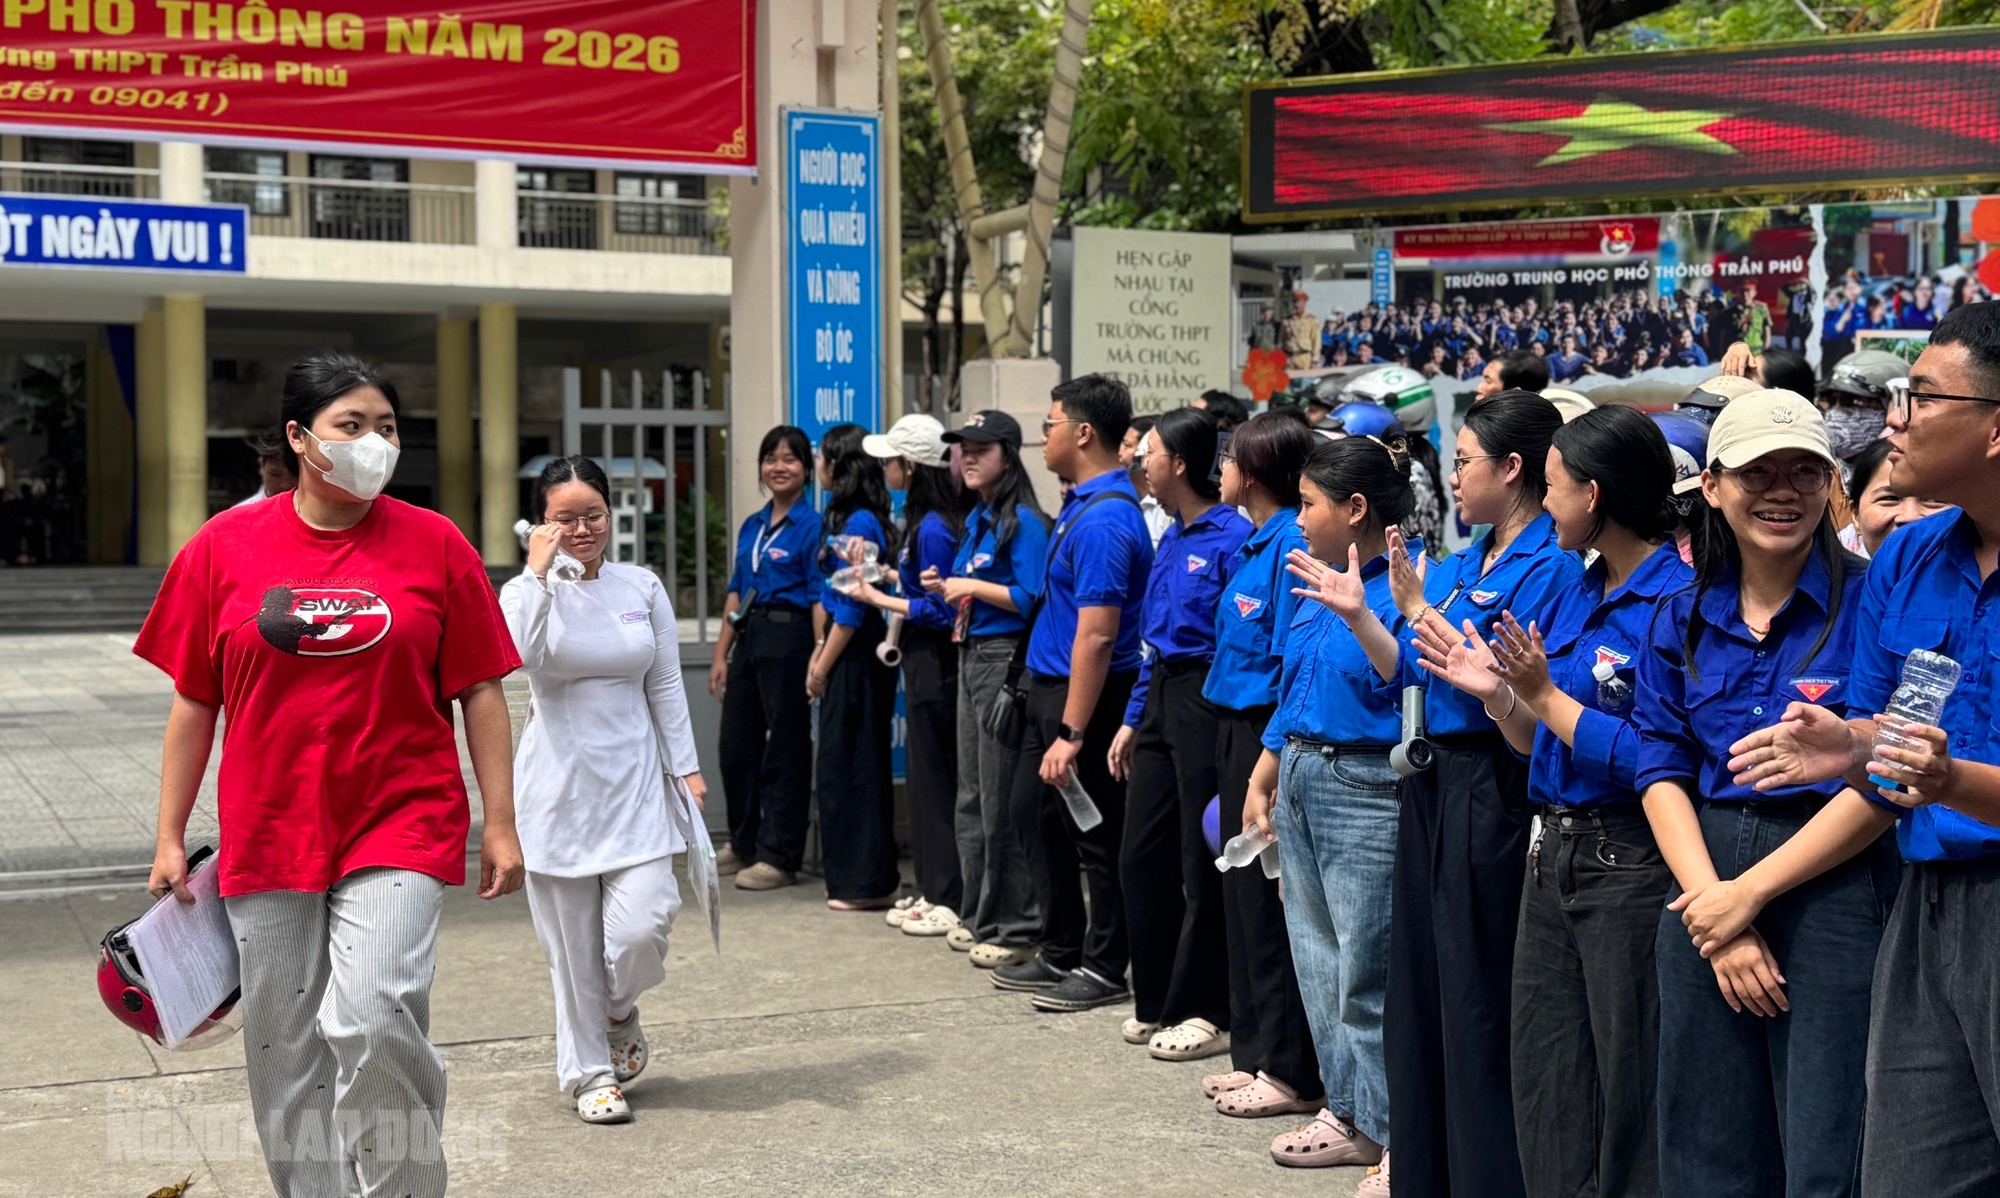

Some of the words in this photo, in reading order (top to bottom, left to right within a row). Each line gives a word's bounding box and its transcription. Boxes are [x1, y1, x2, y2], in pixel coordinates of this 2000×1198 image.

[156, 0, 366, 51] THÔNG
[385, 12, 524, 62] NĂM
[541, 28, 680, 73] 2026
[69, 48, 169, 75] THPT
[179, 54, 264, 82] Trần
[275, 61, 348, 87] Phú
[89, 86, 229, 116] 09041)
[799, 142, 838, 186] NGƯỜI
[840, 151, 866, 194] ĐỌC
[41, 208, 141, 260] NGÀY
[147, 219, 210, 263] VUI
[800, 203, 827, 247] QUÁ
[1116, 250, 1153, 271] HẸN
[1158, 249, 1192, 272] GẶP
[1444, 271, 1509, 289] TRƯỜNG
[1512, 270, 1567, 286] TRUNG
[1570, 268, 1609, 286] HỌC
[1614, 260, 1650, 281] PHỔ
[1654, 261, 1714, 279] THÔNG
[1718, 256, 1763, 276] TRẦN
[1768, 255, 1804, 274] PHÚ
[806, 262, 825, 303] VÀ
[826, 263, 861, 305] DÙNG
[1114, 274, 1164, 292] NHAU
[1168, 276, 1194, 297] TẠI
[1128, 292, 1179, 317] CỔNG
[815, 322, 834, 371] BỘ
[835, 322, 853, 364] ÓC
[1095, 319, 1166, 341] TRƯỜNG
[1170, 325, 1211, 341] THPT
[1107, 343, 1134, 363] MÀ
[1138, 344, 1201, 366] CHÚNG
[815, 381, 841, 425] QUÁ
[842, 381, 855, 422] ÍT
[299, 596, 378, 611] SWAT
